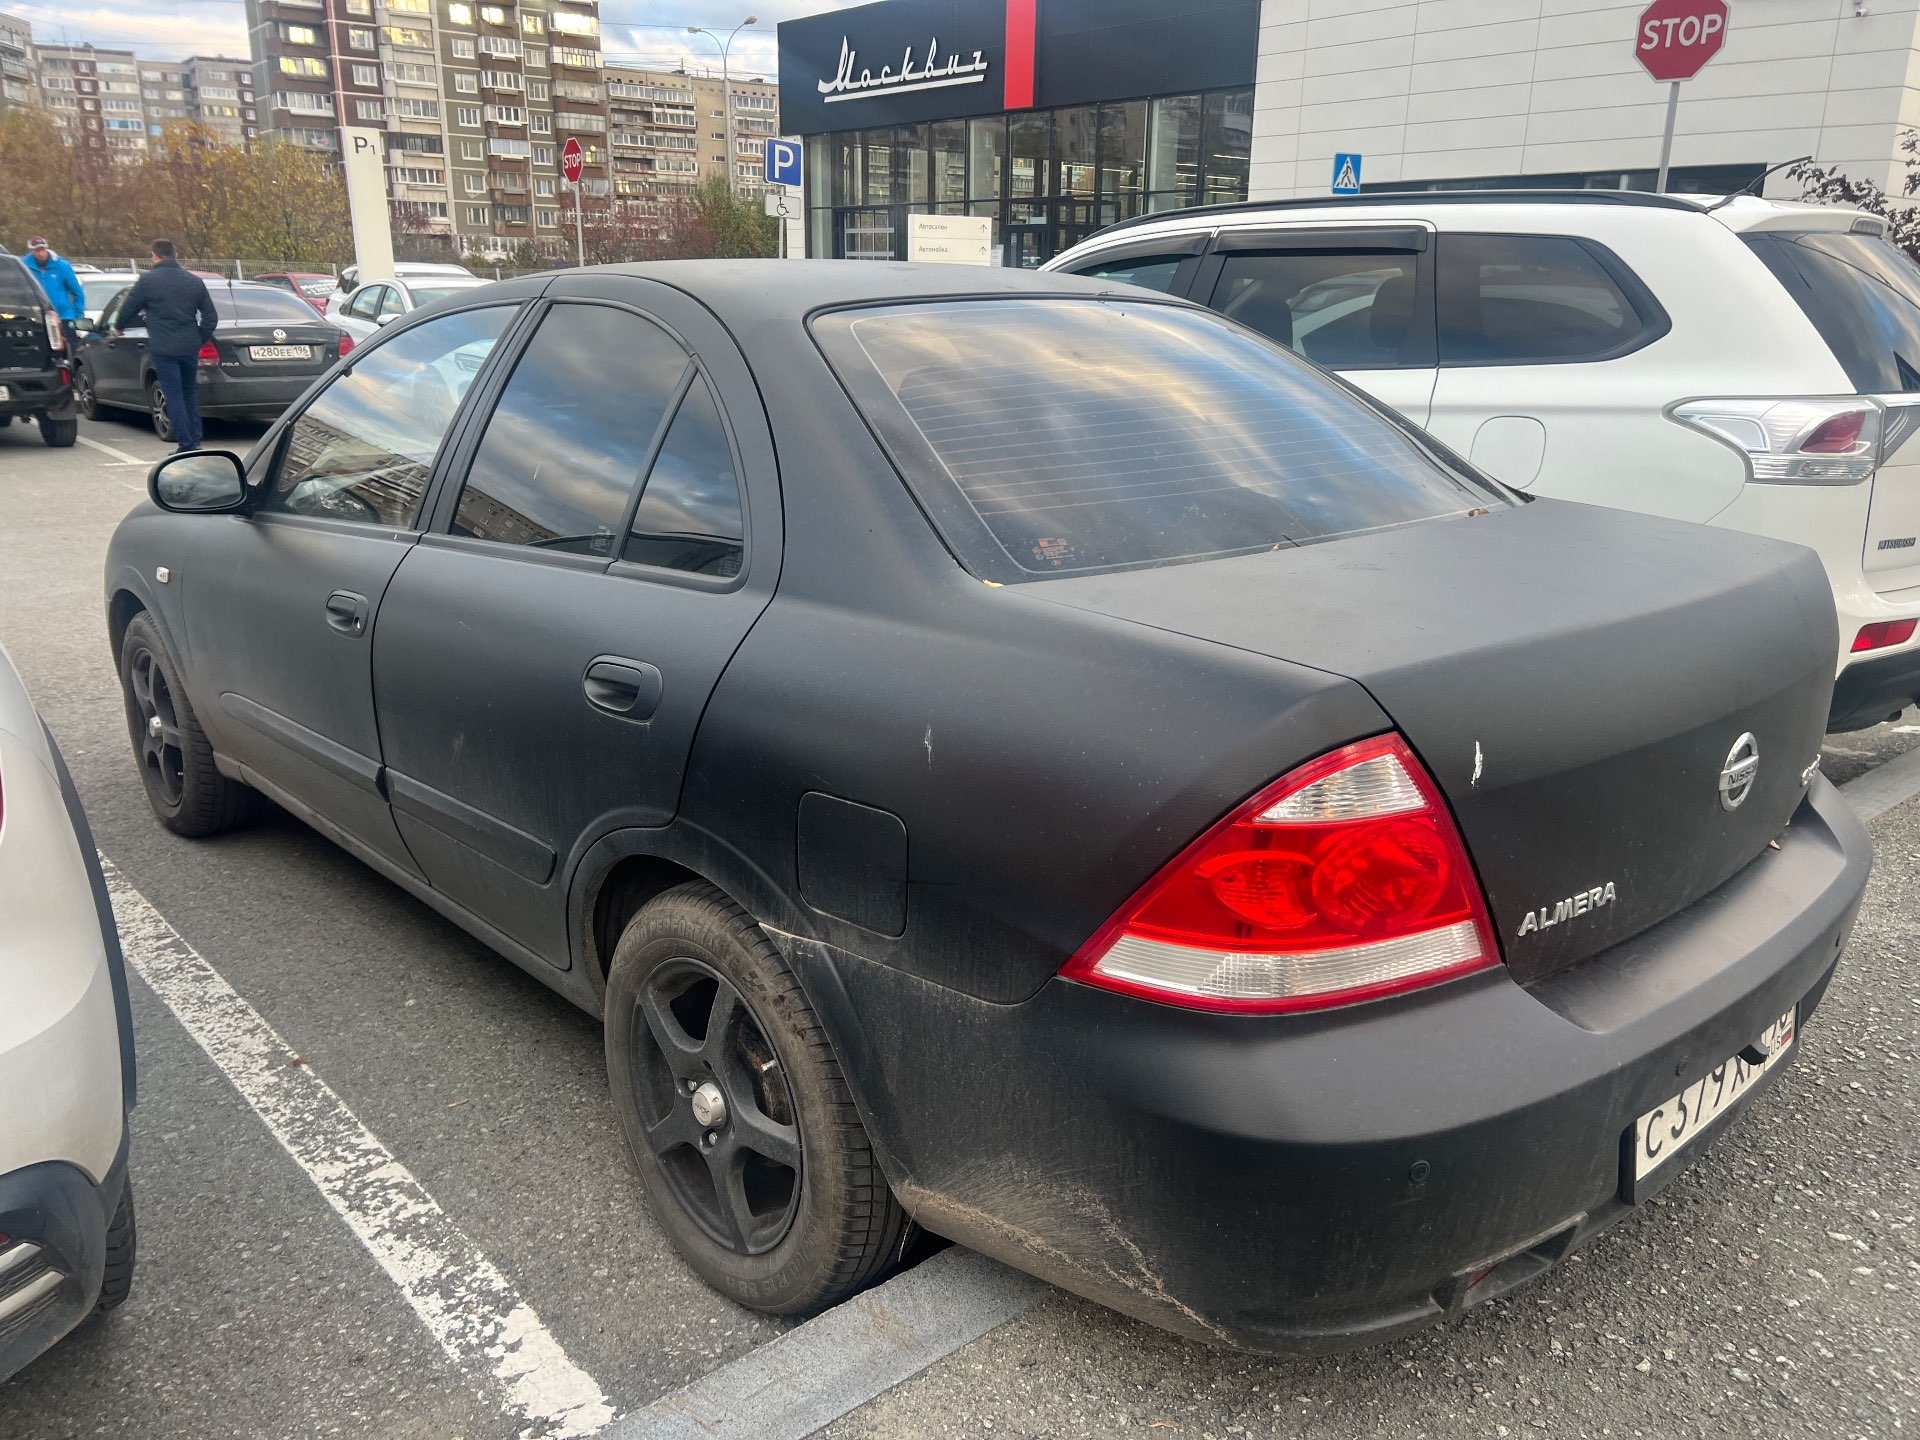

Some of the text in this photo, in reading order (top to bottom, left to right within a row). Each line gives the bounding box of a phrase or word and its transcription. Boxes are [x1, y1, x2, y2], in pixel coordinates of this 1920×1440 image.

[1640, 13, 1723, 50] STOP
[817, 35, 988, 94] Москвич
[564, 153, 581, 169] STOP
[774, 144, 794, 179] P
[1517, 881, 1616, 937] ALMERA
